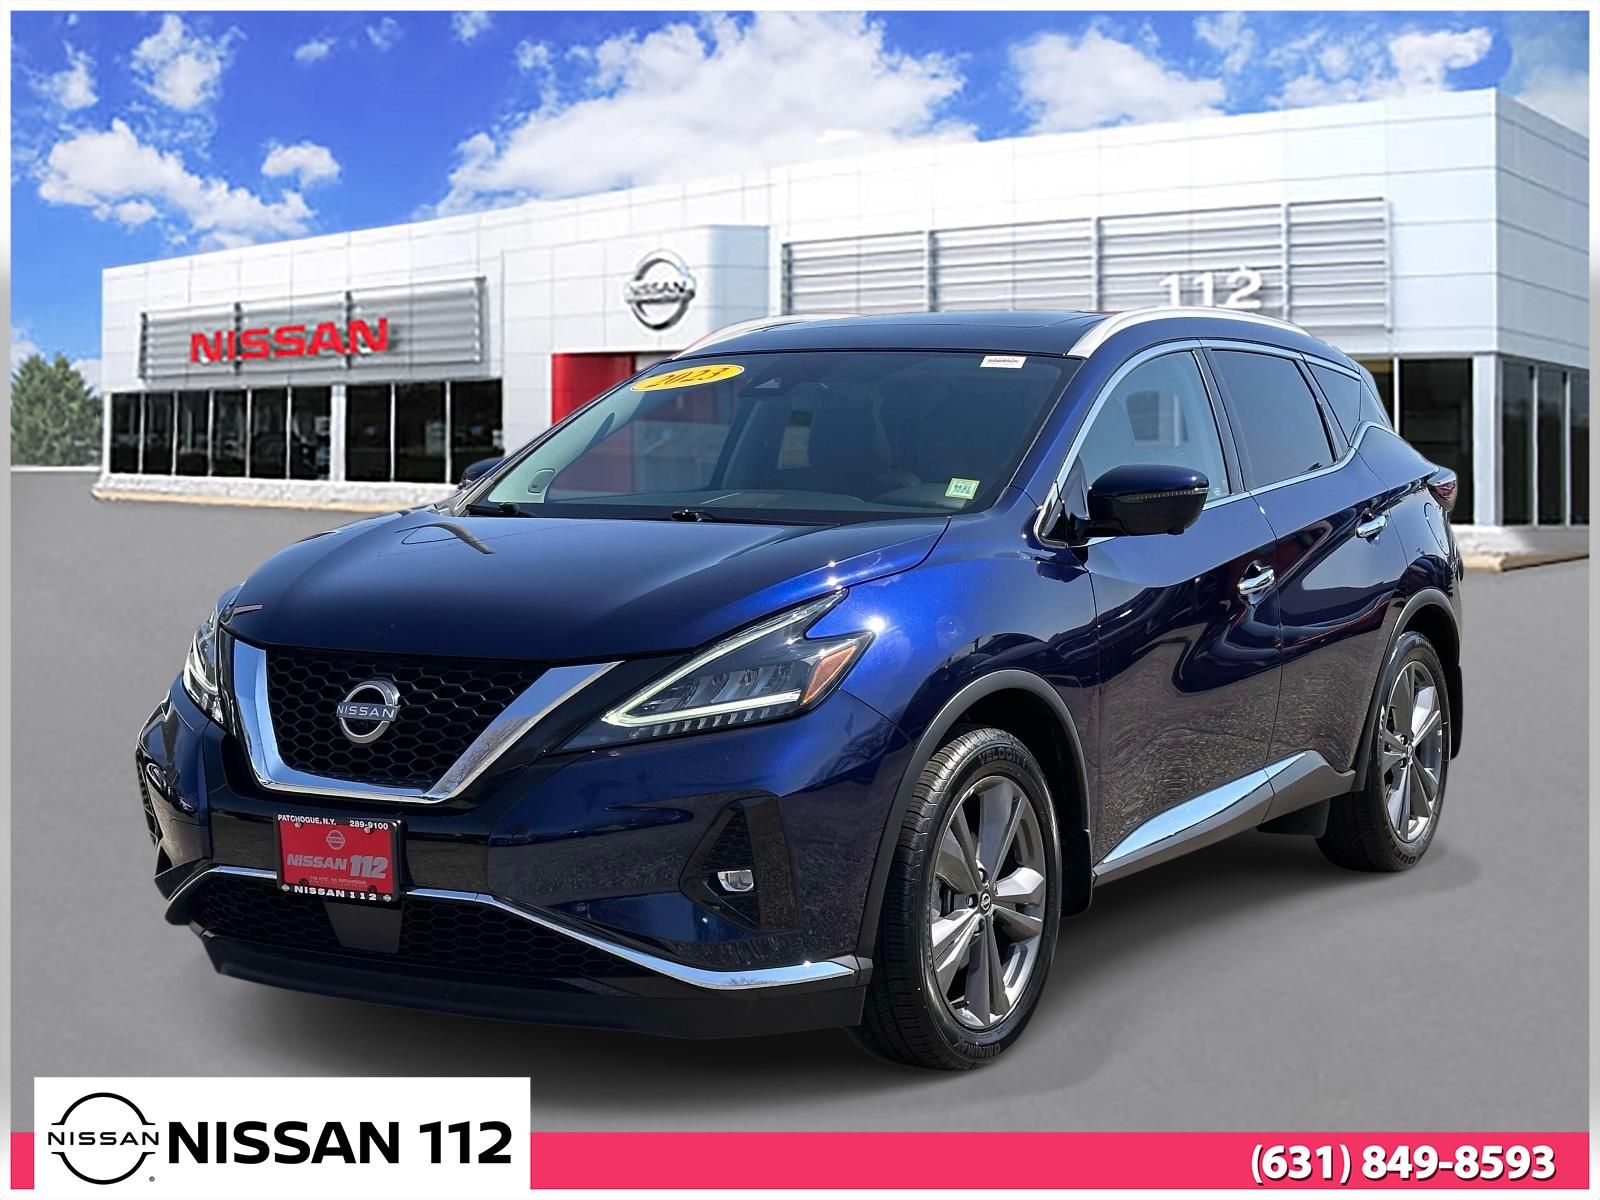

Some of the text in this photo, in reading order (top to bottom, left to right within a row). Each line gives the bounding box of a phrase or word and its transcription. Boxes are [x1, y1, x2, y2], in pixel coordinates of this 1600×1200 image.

[629, 281, 688, 297] NISSAN
[1158, 267, 1263, 309] 112
[190, 317, 388, 364] NISSAN
[643, 367, 730, 388] 2023
[336, 705, 395, 718] NISSAN
[349, 820, 389, 830] 289-9100
[287, 853, 389, 879] NISSAN 112
[294, 885, 345, 898] NISSAN
